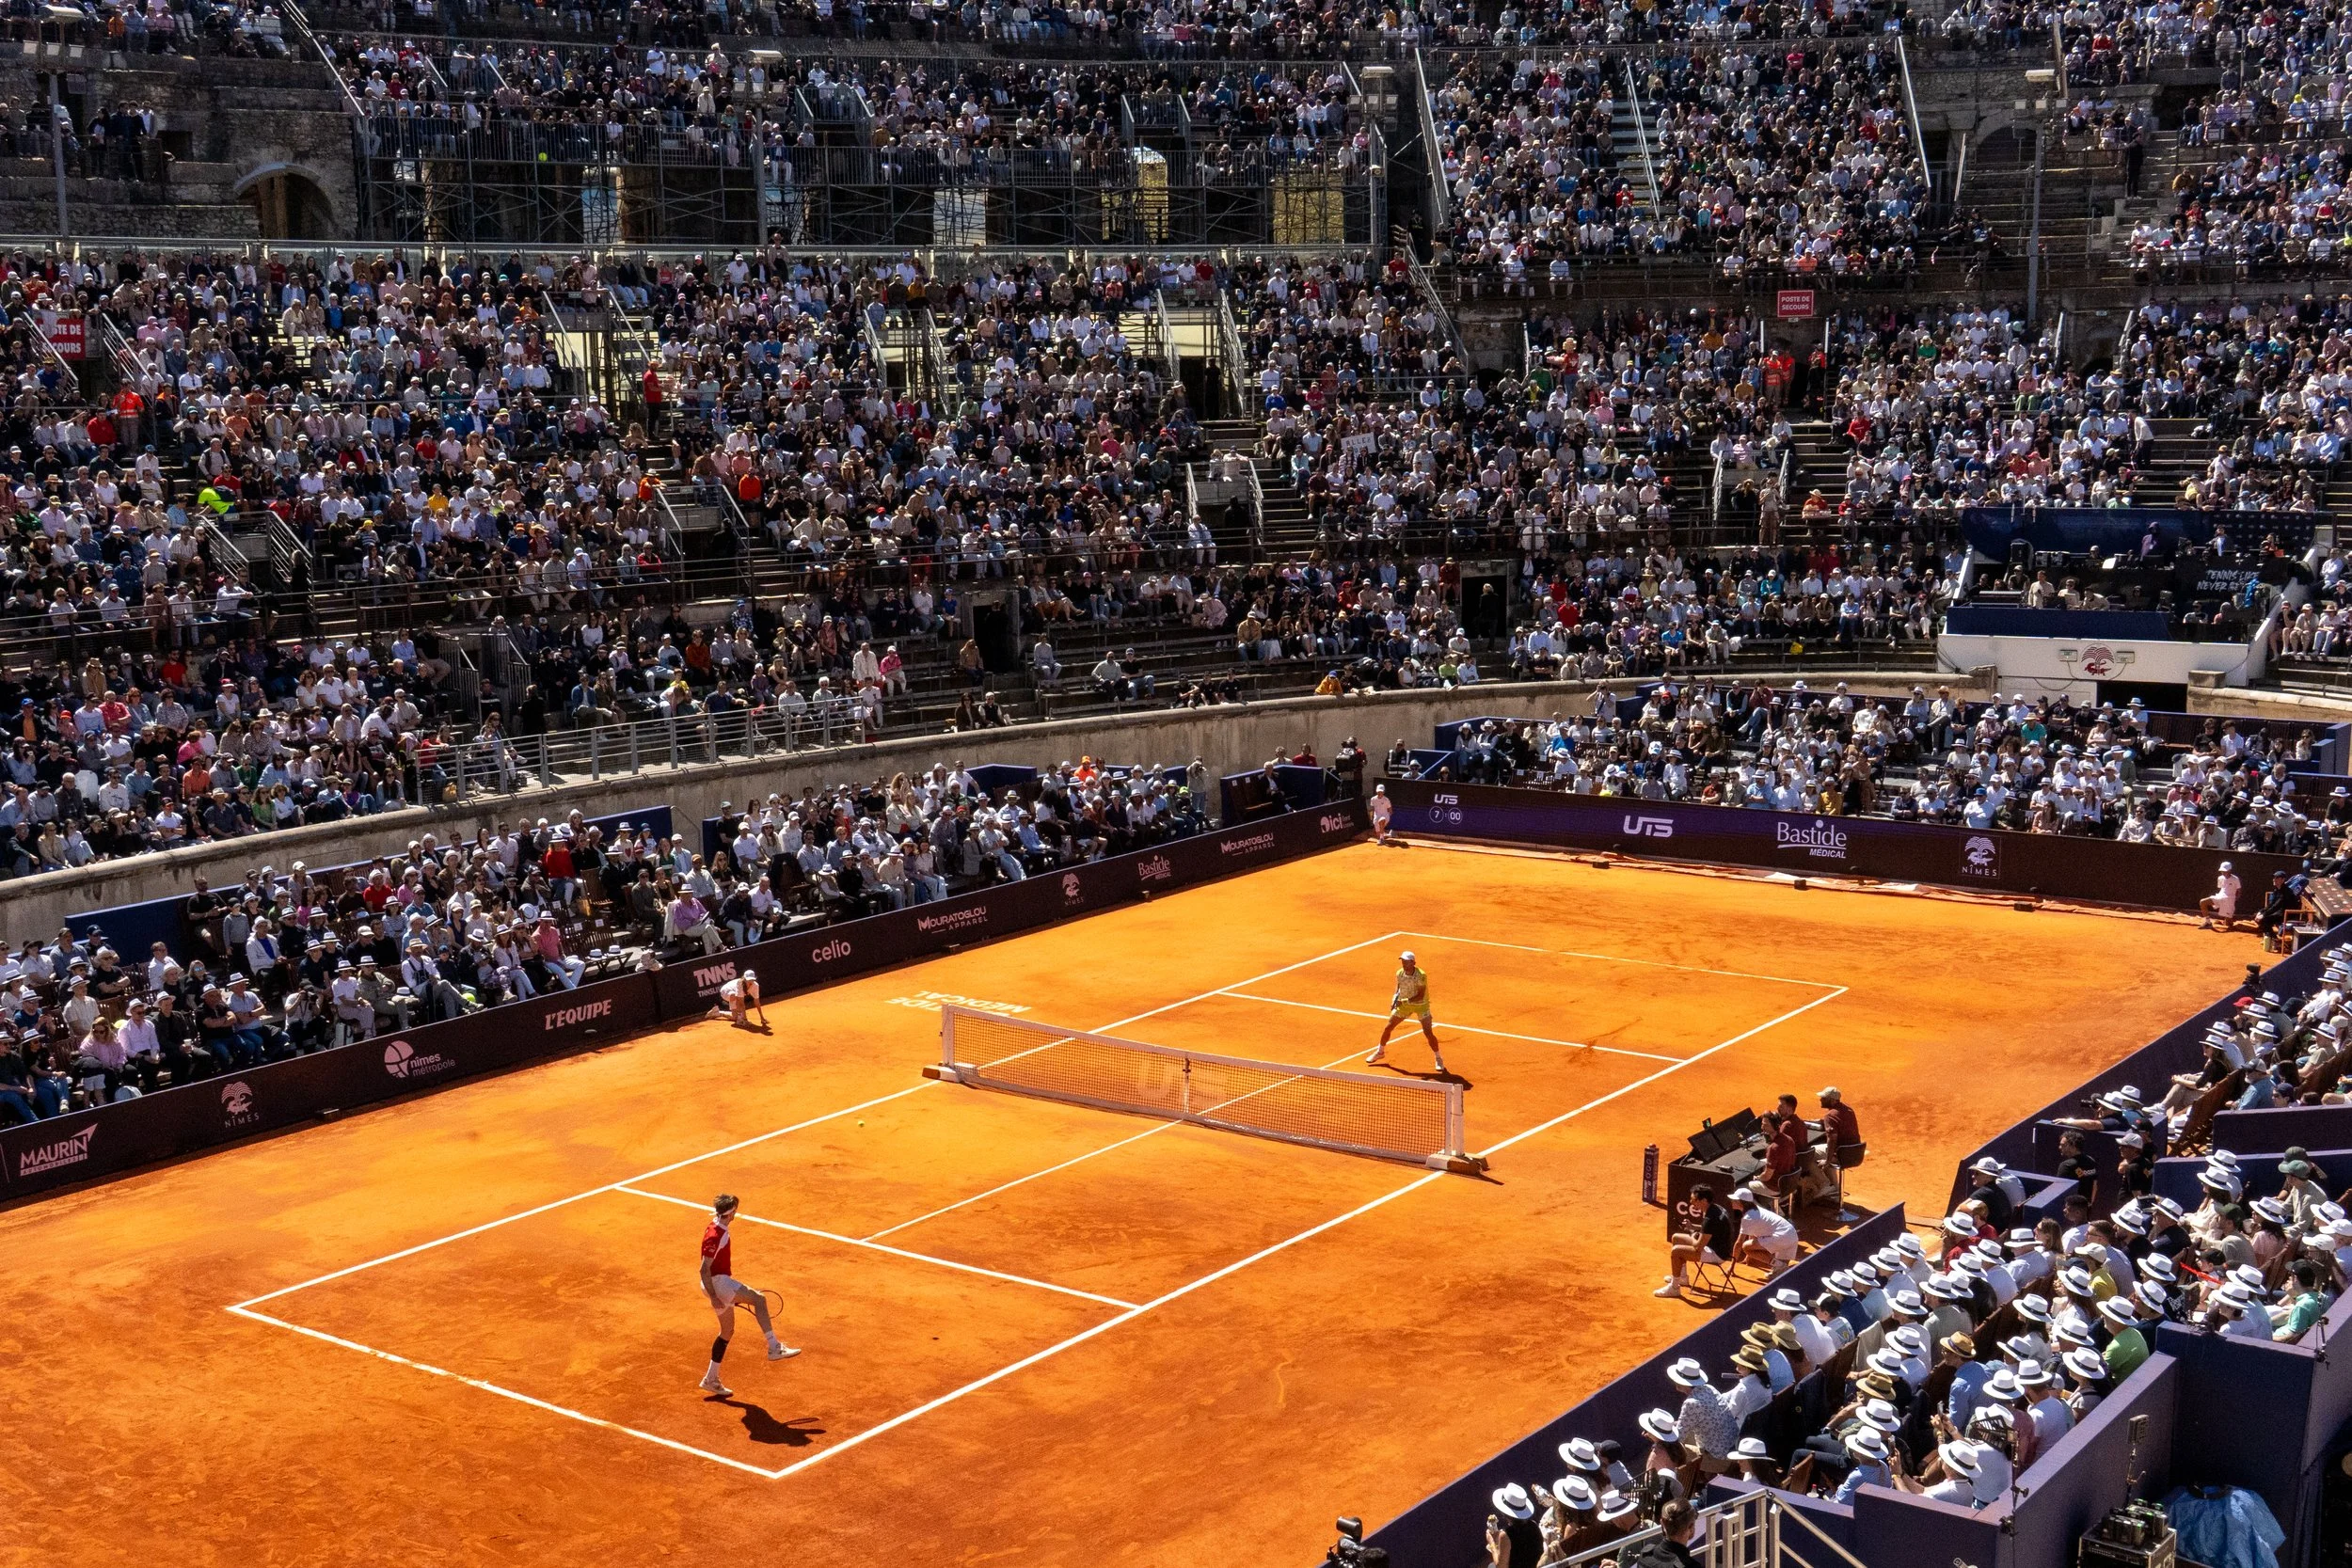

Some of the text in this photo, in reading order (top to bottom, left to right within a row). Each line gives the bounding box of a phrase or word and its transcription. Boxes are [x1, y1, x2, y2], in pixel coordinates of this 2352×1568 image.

[70, 325, 81, 335] DE
[2206, 569, 2238, 580] TENNIS
[2197, 580, 2227, 592] NEVER
[1435, 794, 1458, 804] UTS
[1328, 813, 1343, 831] ici
[1623, 815, 1674, 838] UTS
[1777, 819, 1848, 847] Bastide
[1220, 832, 1274, 854] MOURATOGLOU
[1245, 842, 1275, 853] APPAREL
[1137, 855, 1169, 876] Bastide
[1962, 863, 1997, 877] NÎMES
[917, 906, 987, 931] MOURATOGLOU
[948, 916, 988, 930] APPAREL
[812, 940, 851, 963] celio
[693, 961, 737, 988] TNNS
[410, 1053, 441, 1069] nîmes
[412, 1058, 456, 1077] métropole
[225, 1112, 260, 1128] NÎMES
[21, 1136, 87, 1169] MAURIN
